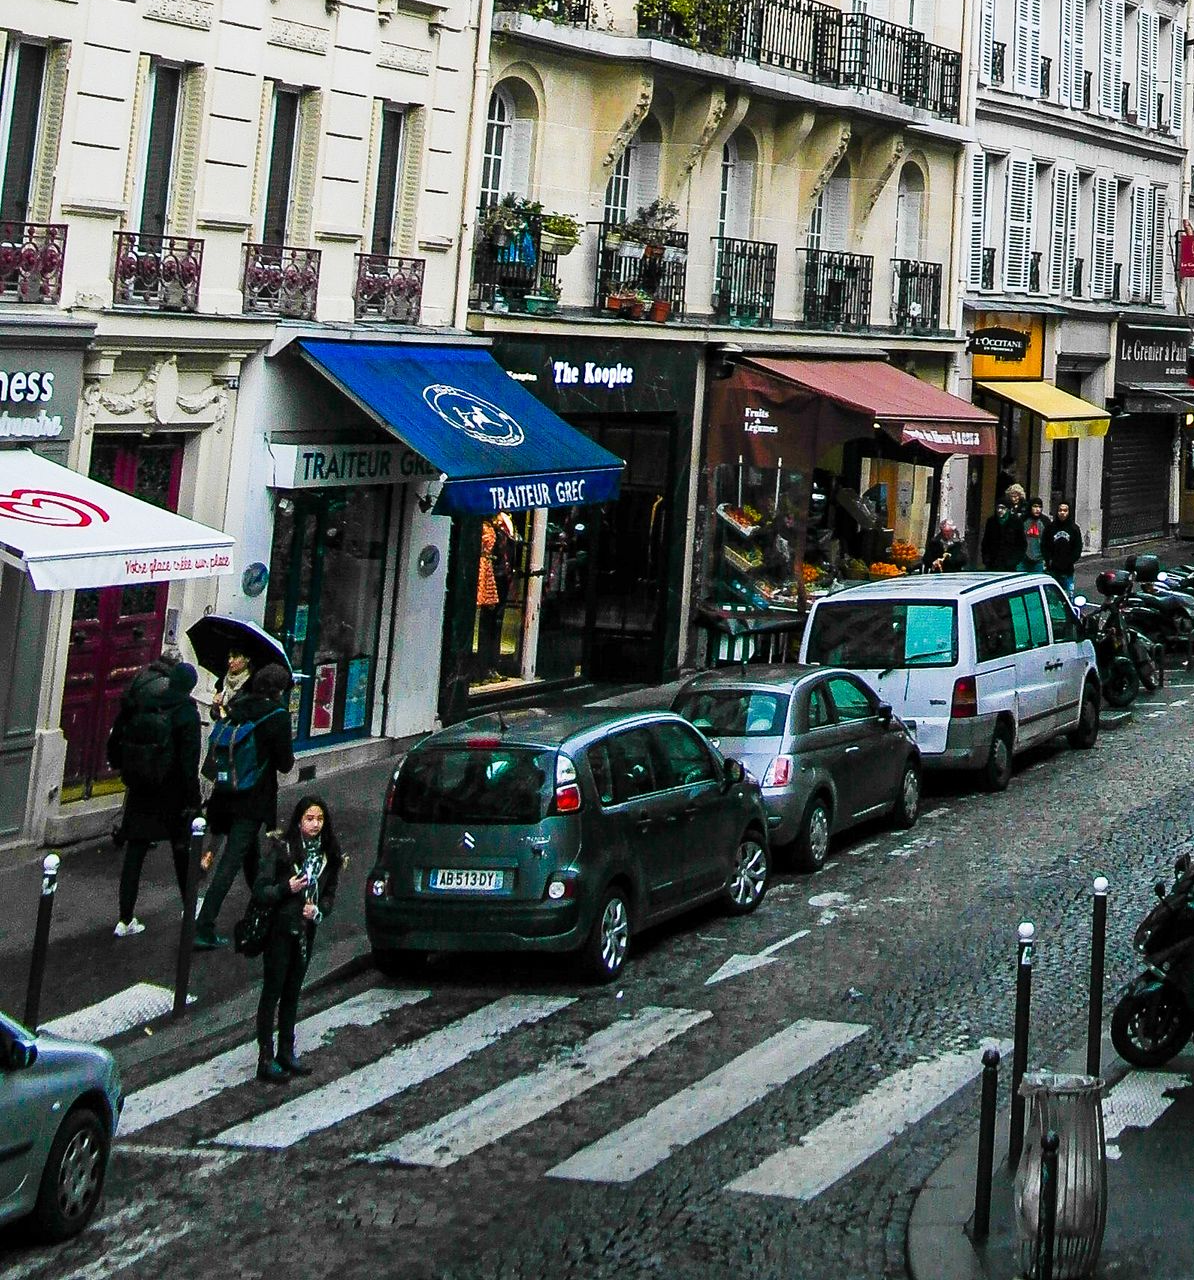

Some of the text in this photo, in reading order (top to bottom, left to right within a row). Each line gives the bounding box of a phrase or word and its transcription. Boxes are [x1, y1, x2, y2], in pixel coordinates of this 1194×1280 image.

[1121, 339, 1132, 360] Le
[1134, 339, 1163, 361] Grenier
[1171, 341, 1187, 361] Pain
[554, 361, 634, 388] The Kooples
[745, 407, 769, 418] Fruits
[302, 450, 392, 480] TRAITEUR
[489, 479, 586, 509] TRAITEUR GREC
[125, 559, 147, 575] Votre
